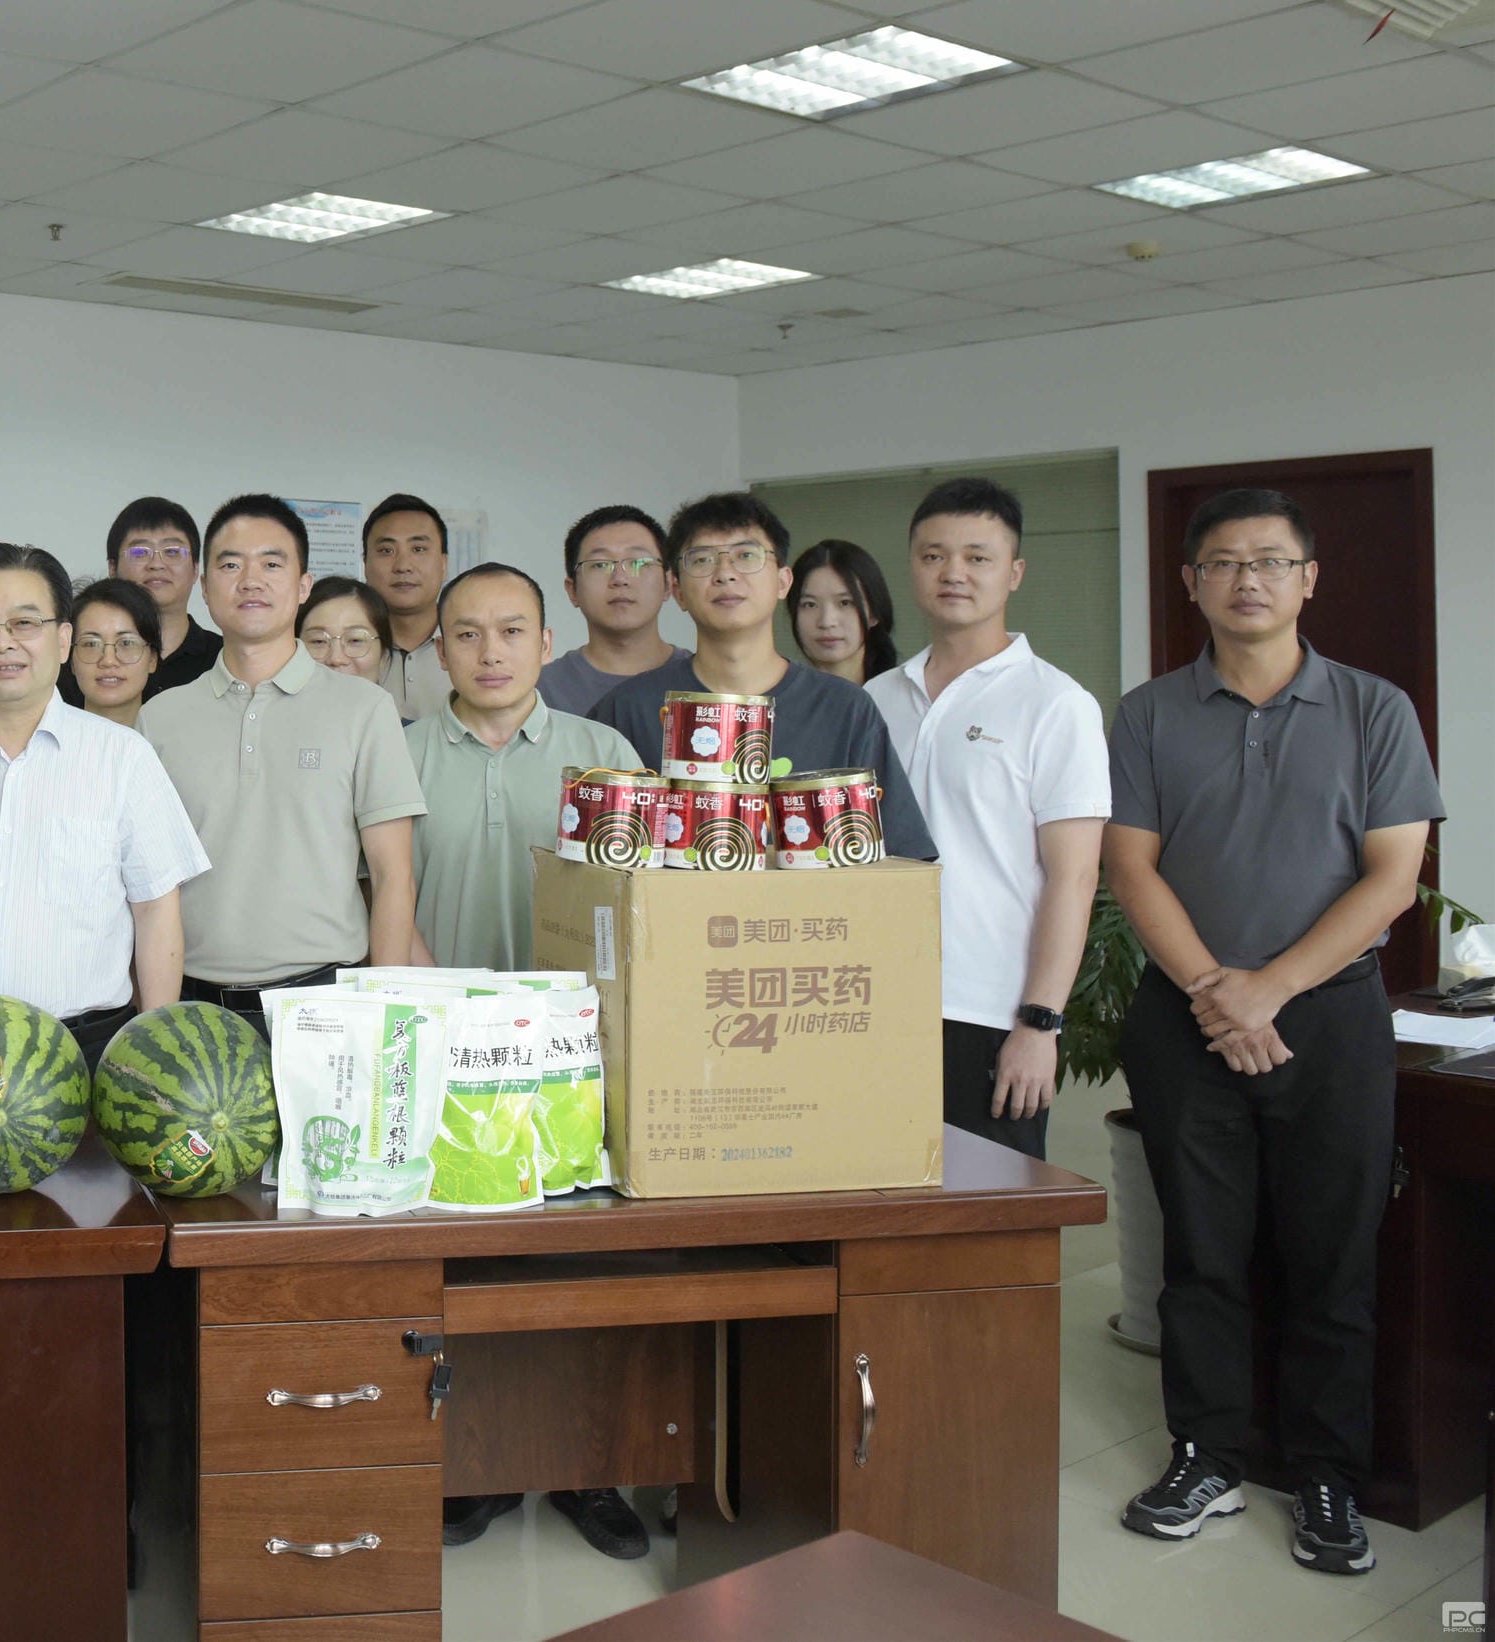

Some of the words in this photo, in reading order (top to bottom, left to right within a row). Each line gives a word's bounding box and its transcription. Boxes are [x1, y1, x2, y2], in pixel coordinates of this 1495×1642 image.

[696, 706, 721, 717] 彩虹
[735, 708, 758, 722] 蚊香
[578, 786, 604, 801] 蚊香
[622, 791, 651, 805] 40
[817, 789, 846, 807] 蚊香
[695, 795, 723, 811] 蚊香
[739, 798, 762, 811] 40
[743, 916, 848, 943] 美团·买药
[705, 964, 872, 1009] 美团买药
[728, 1012, 778, 1054] 24
[784, 1012, 872, 1035] 小时药店
[450, 1045, 534, 1068] 清热颗粒
[382, 1019, 412, 1169] 复方板蓝根颗粒
[648, 1146, 716, 1162] 生产日期：
